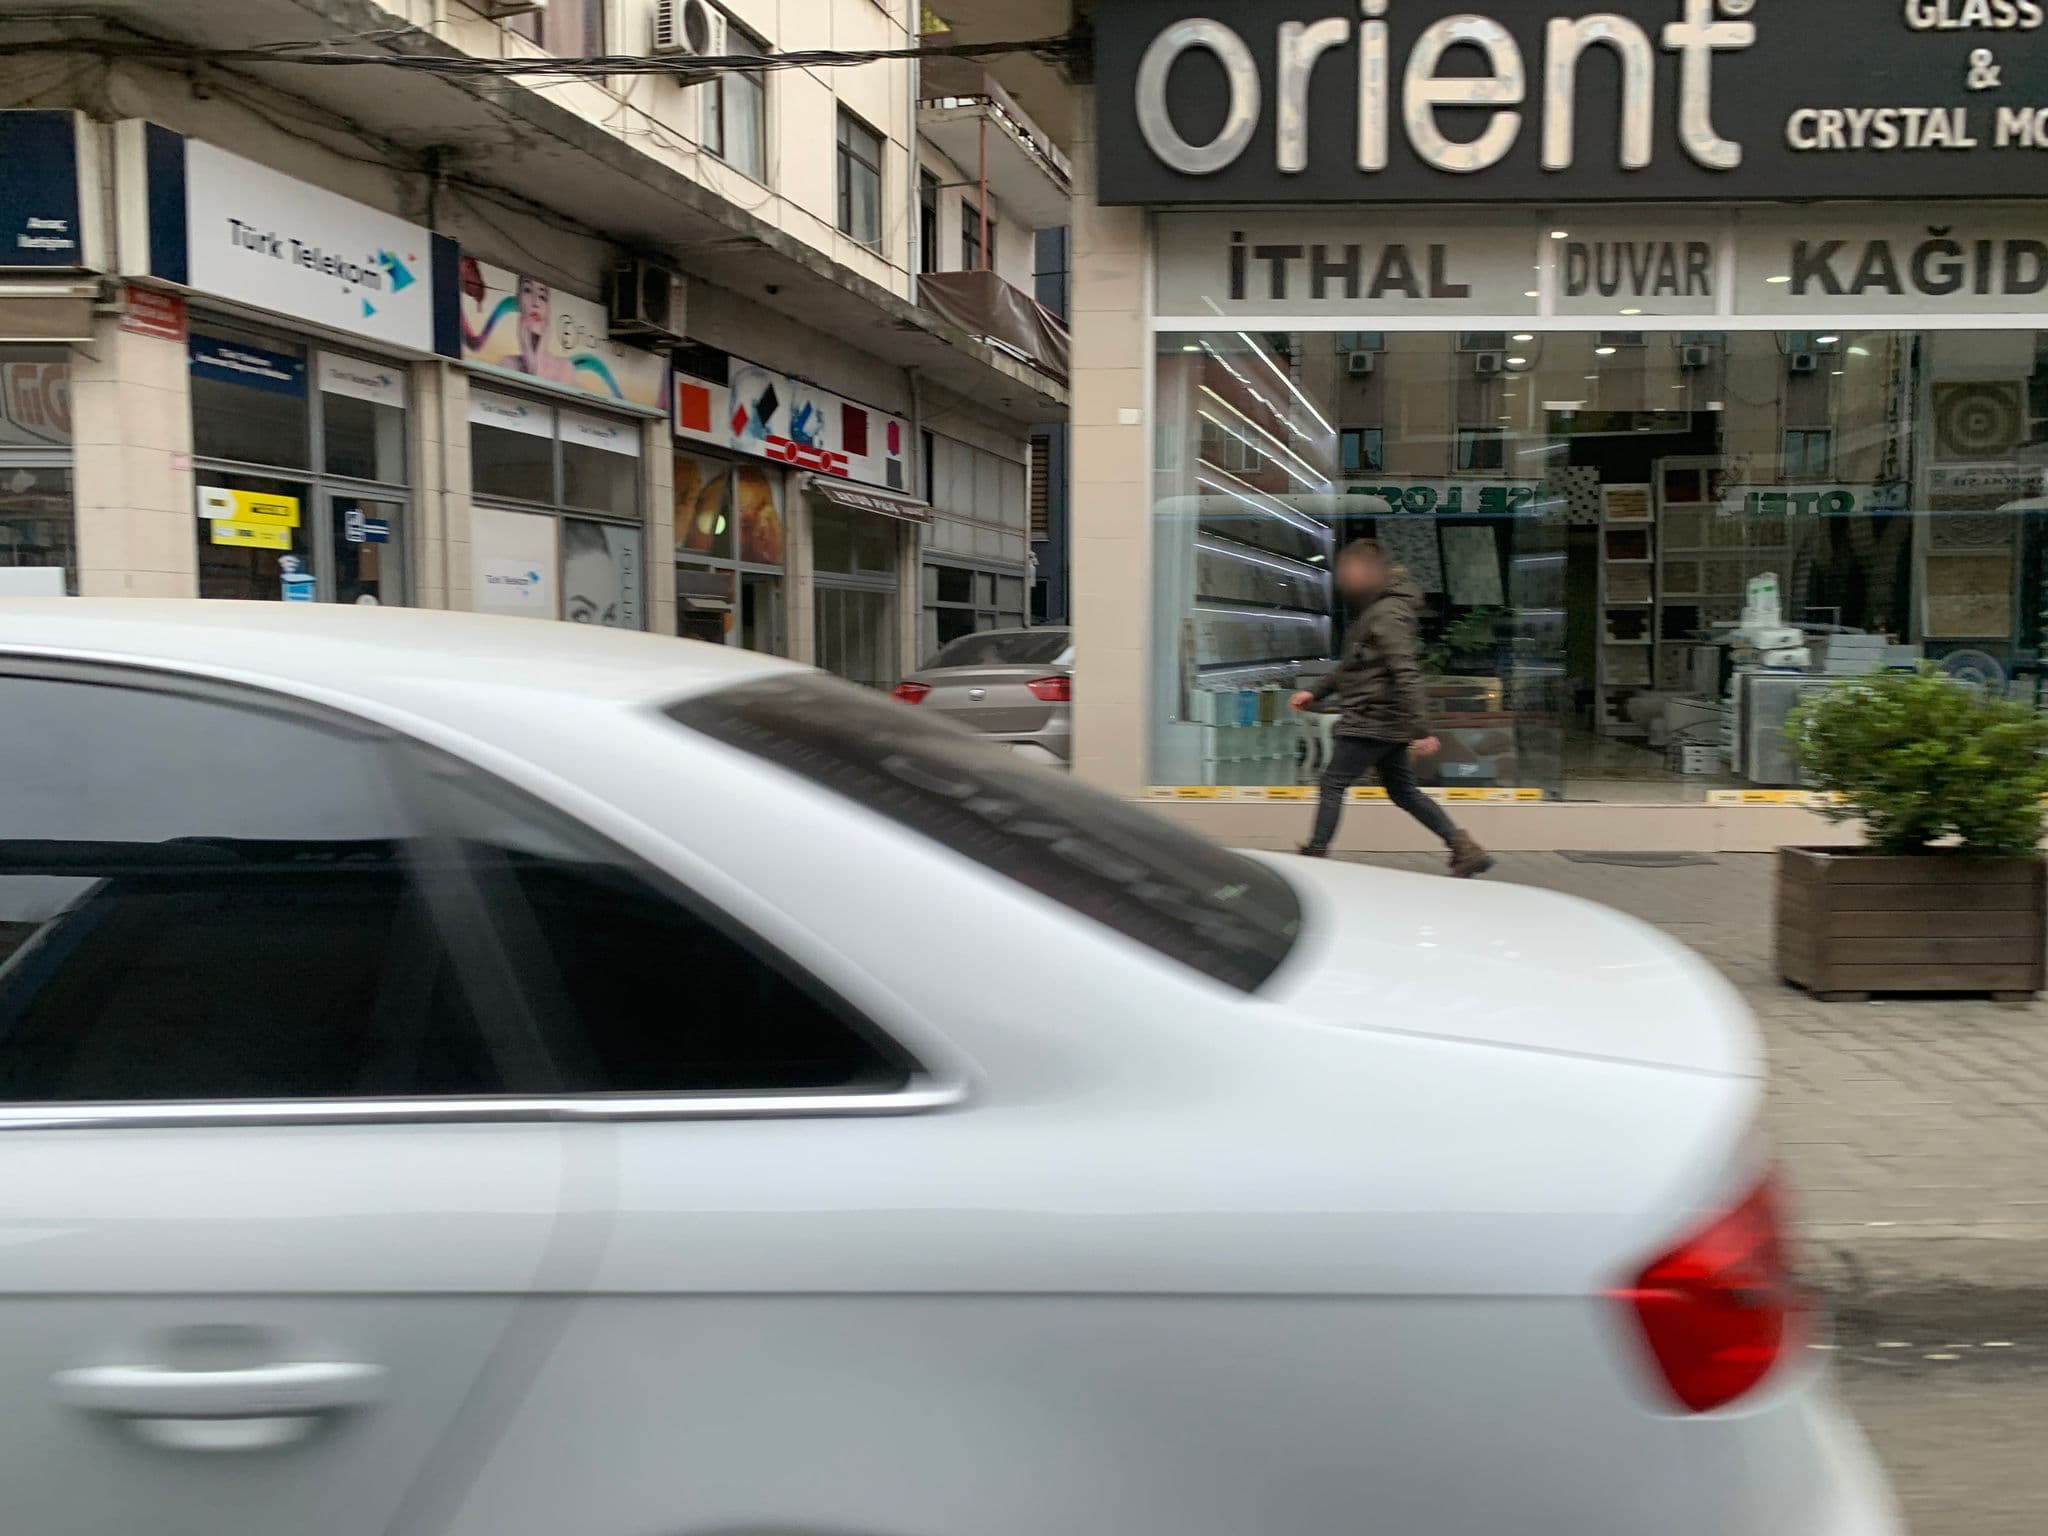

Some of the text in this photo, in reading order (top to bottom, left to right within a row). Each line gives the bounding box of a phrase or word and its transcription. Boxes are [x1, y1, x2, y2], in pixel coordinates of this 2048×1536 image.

[1905, 0, 2044, 30] GLASS
[1134, 0, 1756, 175] orient
[1966, 48, 2002, 90] &
[1786, 106, 1978, 150] CRYSTAL
[228, 217, 382, 291] Türk Telekom
[1227, 231, 1471, 300] İTHAL
[1564, 241, 1712, 297] DUVAR
